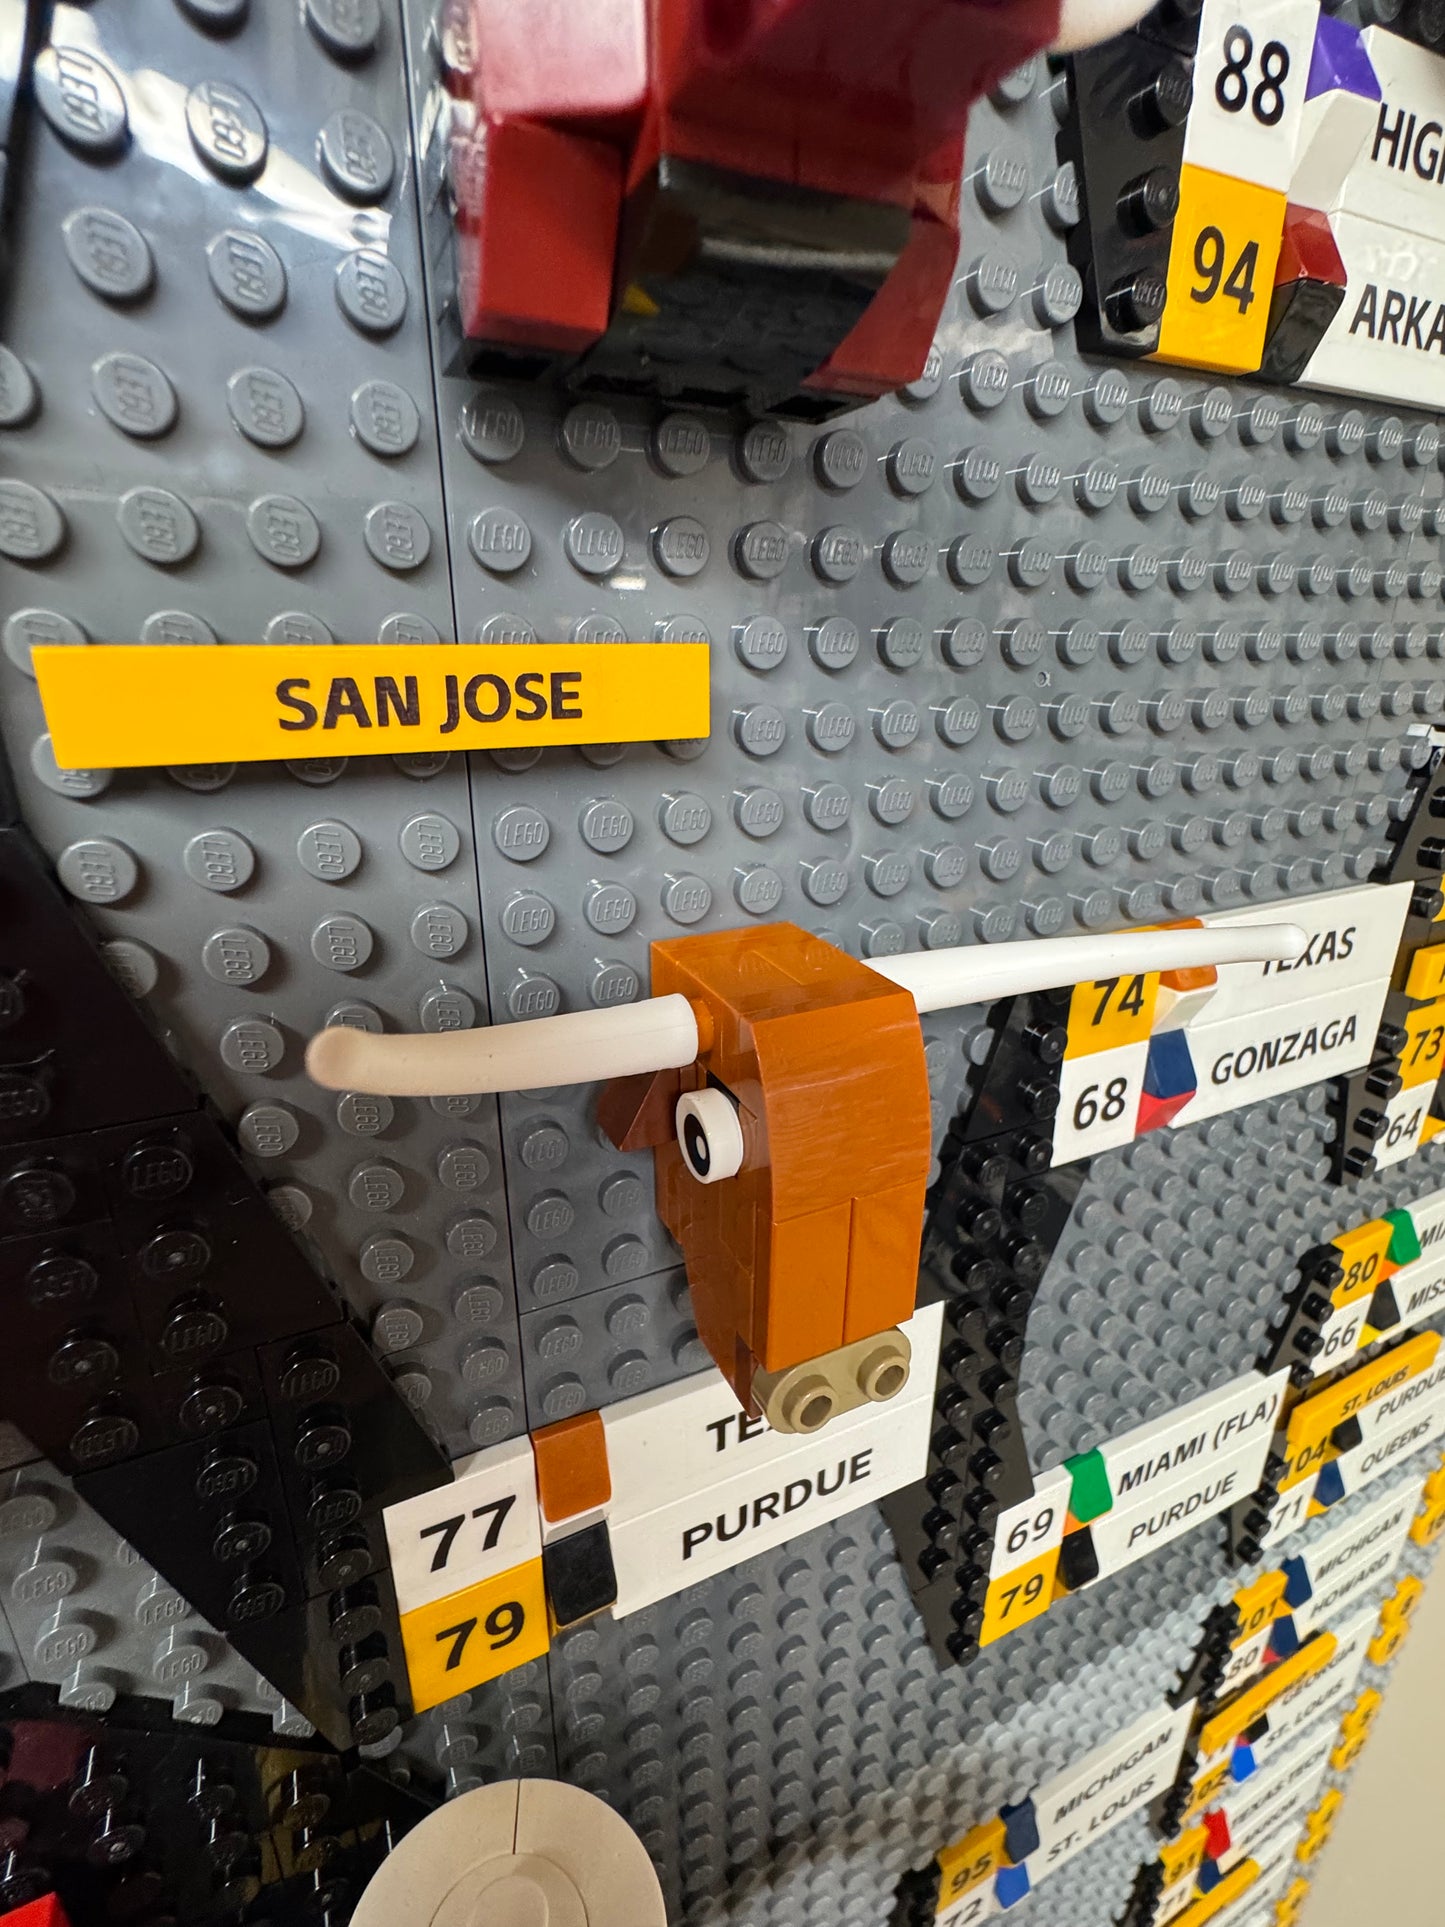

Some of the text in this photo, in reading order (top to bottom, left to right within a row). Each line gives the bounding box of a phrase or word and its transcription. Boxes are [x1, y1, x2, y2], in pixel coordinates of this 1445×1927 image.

[1215, 23, 1290, 126] 88
[1371, 102, 1445, 184] HIG
[1189, 225, 1259, 315] 94
[480, 524, 524, 552] LEGO
[577, 528, 618, 555] LEGO
[667, 532, 704, 559] LEGO
[750, 537, 785, 561] LEGO
[825, 538, 858, 565] LEGO
[750, 631, 782, 655] LEGO
[823, 631, 855, 654] LEGO
[275, 672, 583, 733] SAN JOSE
[748, 720, 781, 742] LEGO
[820, 716, 853, 737] LEGO
[886, 712, 917, 735] LEGO
[746, 802, 781, 825] LEGO
[816, 797, 847, 819] LEGO
[884, 791, 911, 813] LEGO
[503, 822, 544, 847] LEGO
[590, 815, 630, 840] LEGO
[671, 810, 705, 832] LEGO
[314, 831, 345, 874] LEGO
[418, 824, 445, 864] LEGO
[80, 850, 116, 896] LEGO
[202, 840, 237, 884] LEGO
[673, 890, 707, 912] LEGO
[746, 880, 777, 903] LEGO
[815, 875, 845, 895] LEGO
[511, 908, 550, 933] LEGO
[595, 899, 632, 921] LEGO
[327, 926, 356, 965] LEGO
[427, 915, 453, 952] LEGO
[220, 939, 252, 980] LEGO
[517, 991, 554, 1014] LEGO
[600, 976, 633, 999] LEGO
[1091, 974, 1145, 1026] 74
[237, 1030, 269, 1069] LEGO
[1211, 1015, 1357, 1085] GONZAGA
[1409, 1025, 1445, 1067] 73
[1073, 1077, 1128, 1130] 68
[253, 1115, 282, 1151] LEGO
[1386, 1107, 1423, 1147] 64
[529, 1139, 568, 1163] LEGO
[455, 1155, 477, 1189] LEGO
[364, 1174, 391, 1208] LEGO
[534, 1207, 570, 1231] LEGO
[460, 1225, 484, 1257] LEGO
[376, 1249, 400, 1280] LEGO
[1343, 1253, 1379, 1292] 80
[541, 1273, 576, 1296] LEGO
[469, 1292, 490, 1322] LEGO
[386, 1316, 409, 1349] LEGO
[548, 1334, 580, 1355] LEGO
[1323, 1317, 1360, 1357] 66
[551, 1391, 581, 1413] LEGO
[1339, 1364, 1410, 1417] ST. LOUIS
[1116, 1393, 1278, 1496] MIAMI (FLA)
[1284, 1436, 1328, 1481] 104
[1361, 1414, 1433, 1474] QUEENS
[681, 1448, 874, 1562] PURDUE
[1126, 1471, 1238, 1549] PURDUE
[1274, 1494, 1304, 1531] 71
[418, 1493, 517, 1575] 77
[1005, 1507, 1055, 1554] 69
[1315, 1509, 1404, 1583] MICHIGAN
[22, 1572, 70, 1603] LEGO
[999, 1573, 1044, 1621] 79
[1308, 1552, 1390, 1617] HOWARD
[143, 1597, 186, 1626] LEGO
[42, 1632, 88, 1664] LEGO
[434, 1600, 527, 1673] 79
[159, 1653, 201, 1682] LEGO
[1052, 1727, 1173, 1824] MICHIGAN
[1047, 1773, 1157, 1863] ST. LOUIS
[951, 1850, 993, 1895] 95
